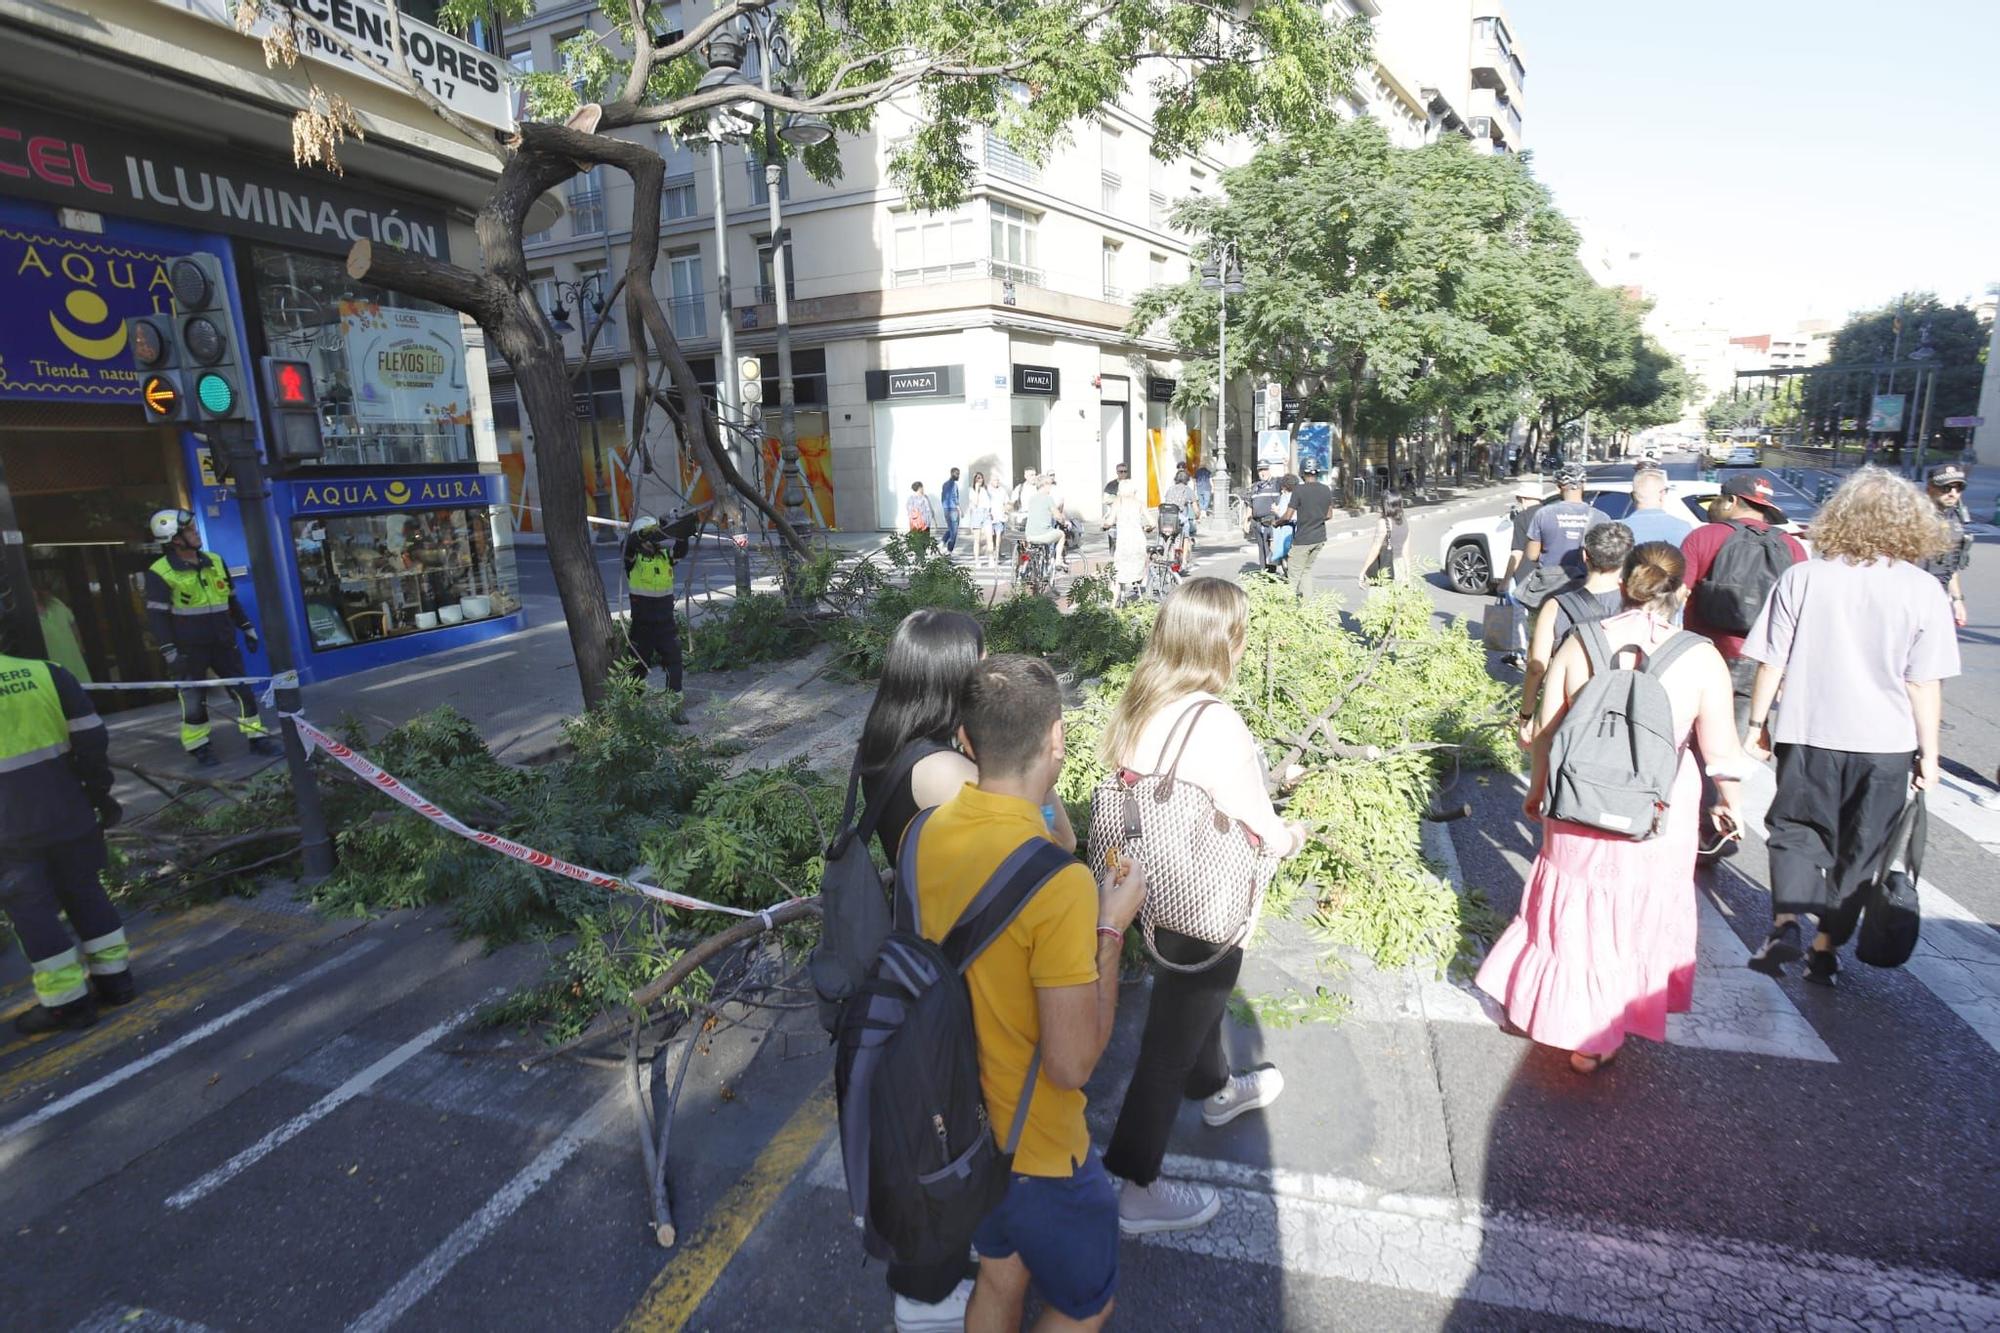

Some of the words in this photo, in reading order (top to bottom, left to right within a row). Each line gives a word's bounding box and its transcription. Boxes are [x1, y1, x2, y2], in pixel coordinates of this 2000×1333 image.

[283, 0, 499, 94] CENSORES
[432, 76, 455, 100] 17
[125, 155, 438, 259] ILUMINACIÓN
[18, 245, 174, 294] AQUA
[30, 359, 90, 379] Tienda
[378, 351, 424, 373] FLEXOS
[426, 355, 445, 375] LED
[895, 378, 932, 388] AVANZA
[1026, 375, 1050, 385] AVANZA
[303, 485, 378, 506] AQUA
[421, 480, 482, 500] AURA
